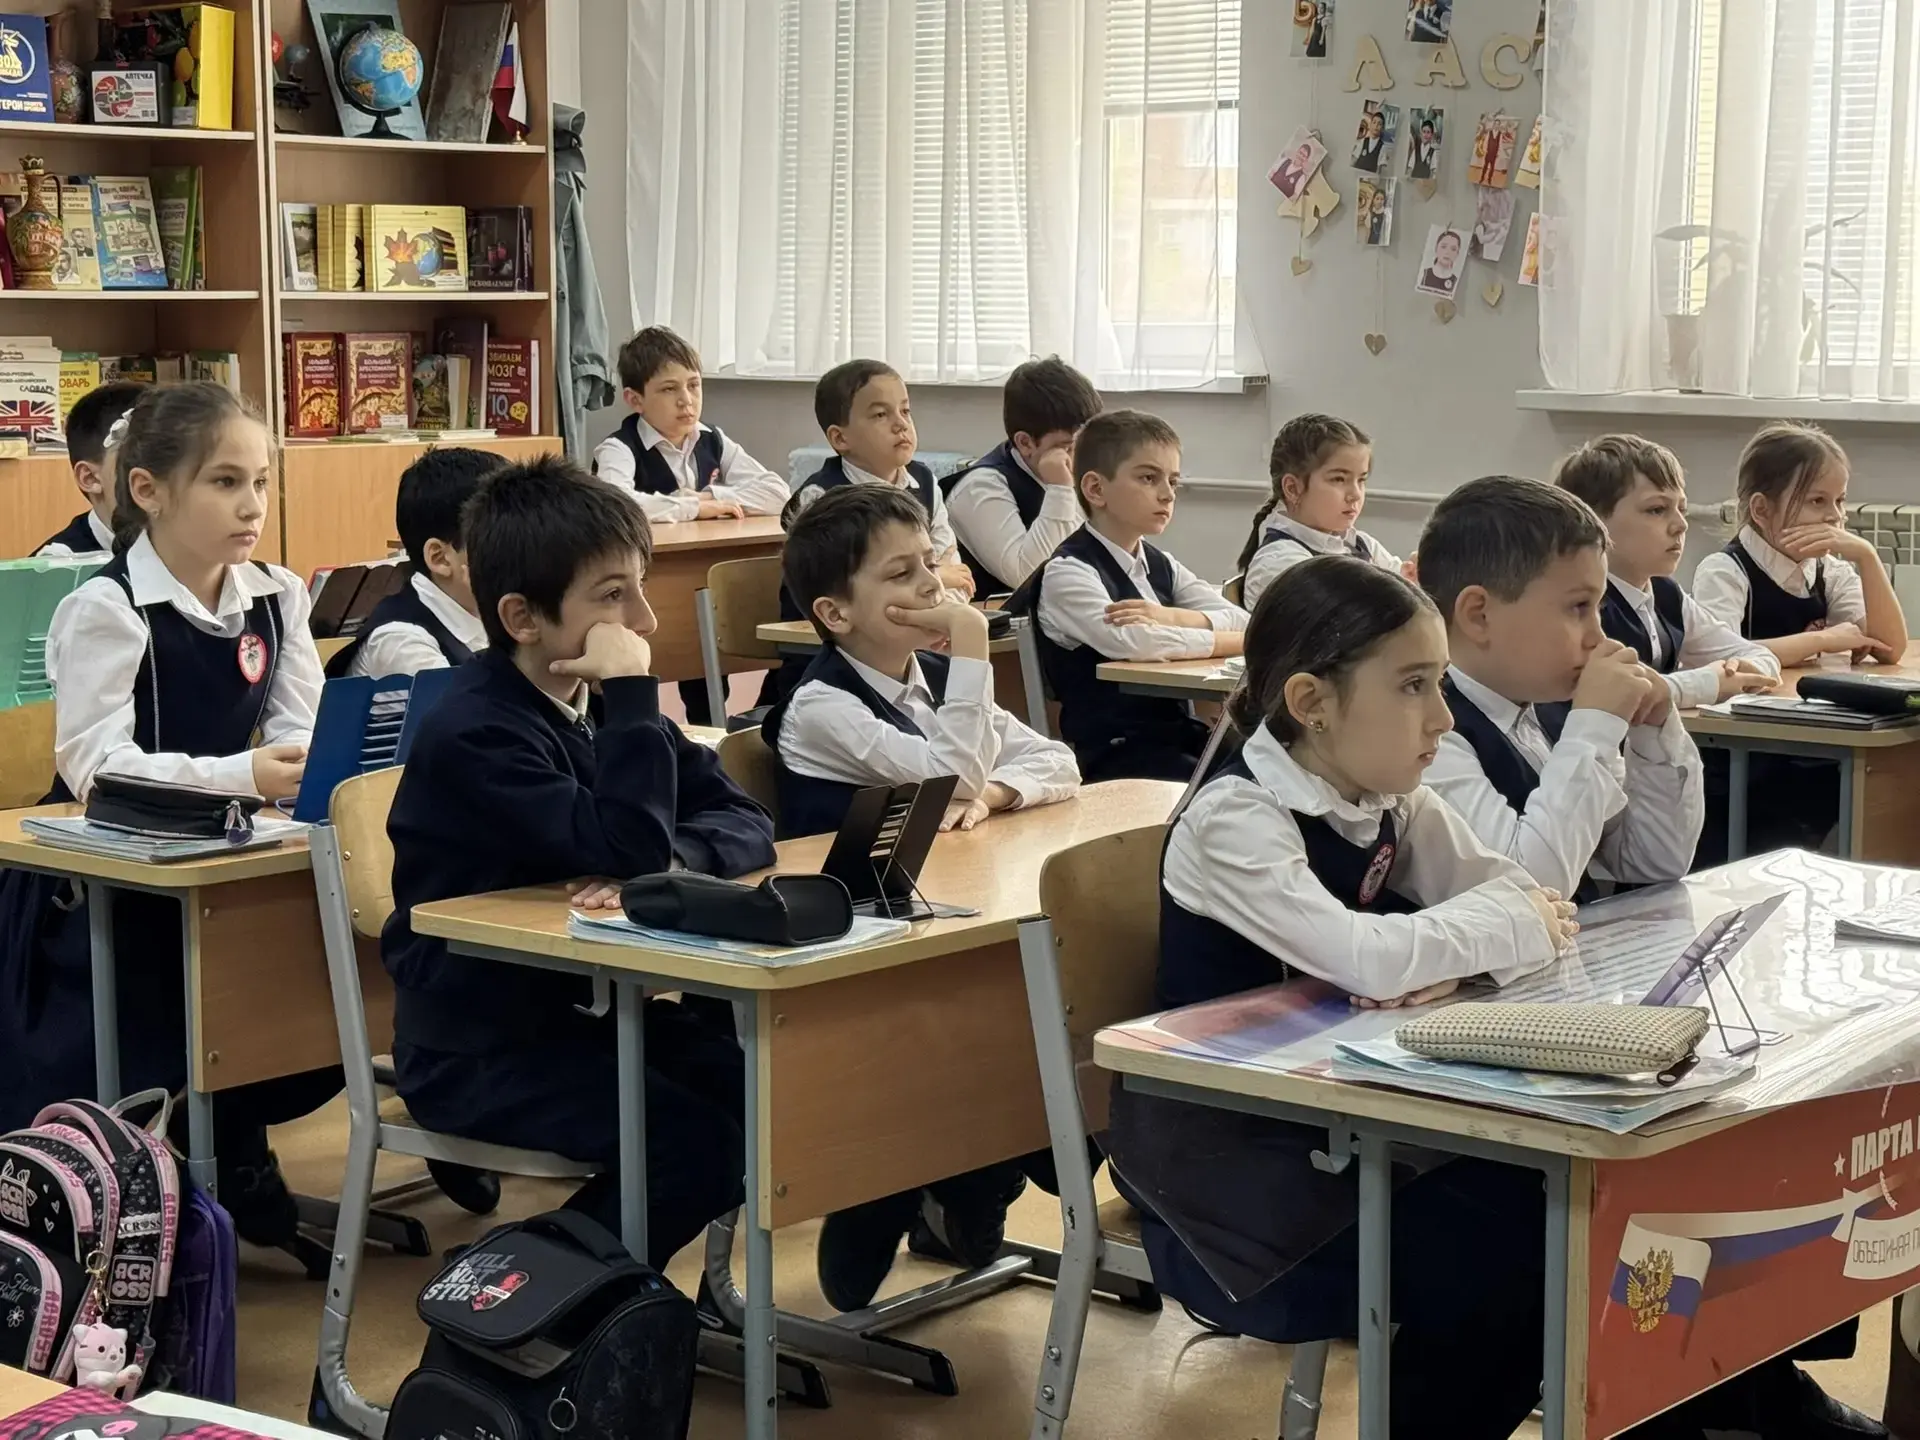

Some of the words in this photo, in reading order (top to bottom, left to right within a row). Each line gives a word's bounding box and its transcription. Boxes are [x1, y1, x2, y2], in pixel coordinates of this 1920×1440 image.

[487, 364, 515, 378] МОЗГ
[20, 385, 55, 394] СЛОВАРЬ
[492, 394, 510, 421] IQ
[1851, 1118, 1914, 1182] ПАРТА
[114, 1262, 152, 1281] ACR
[111, 1281, 150, 1299] OSS
[33, 1290, 61, 1364] ACROSS
